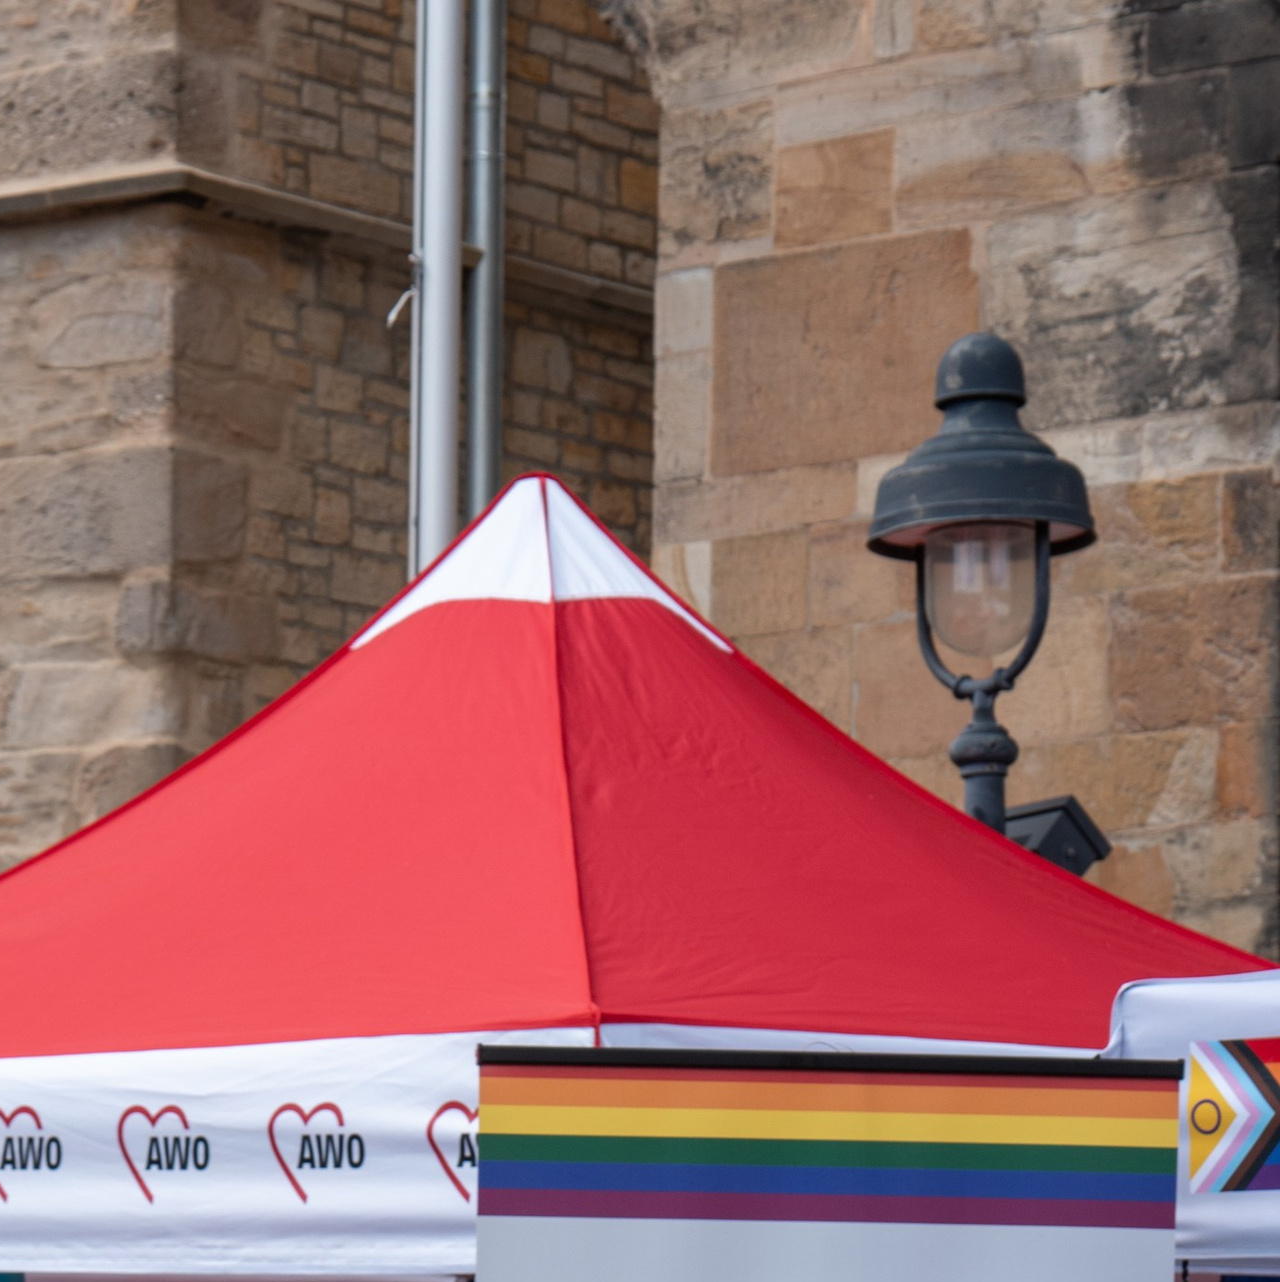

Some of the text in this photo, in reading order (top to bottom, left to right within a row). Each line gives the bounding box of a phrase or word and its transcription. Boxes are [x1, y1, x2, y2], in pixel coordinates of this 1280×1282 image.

[0, 1136, 62, 1170] AWO
[145, 1136, 210, 1170] AWO
[297, 1133, 365, 1169] AWO
